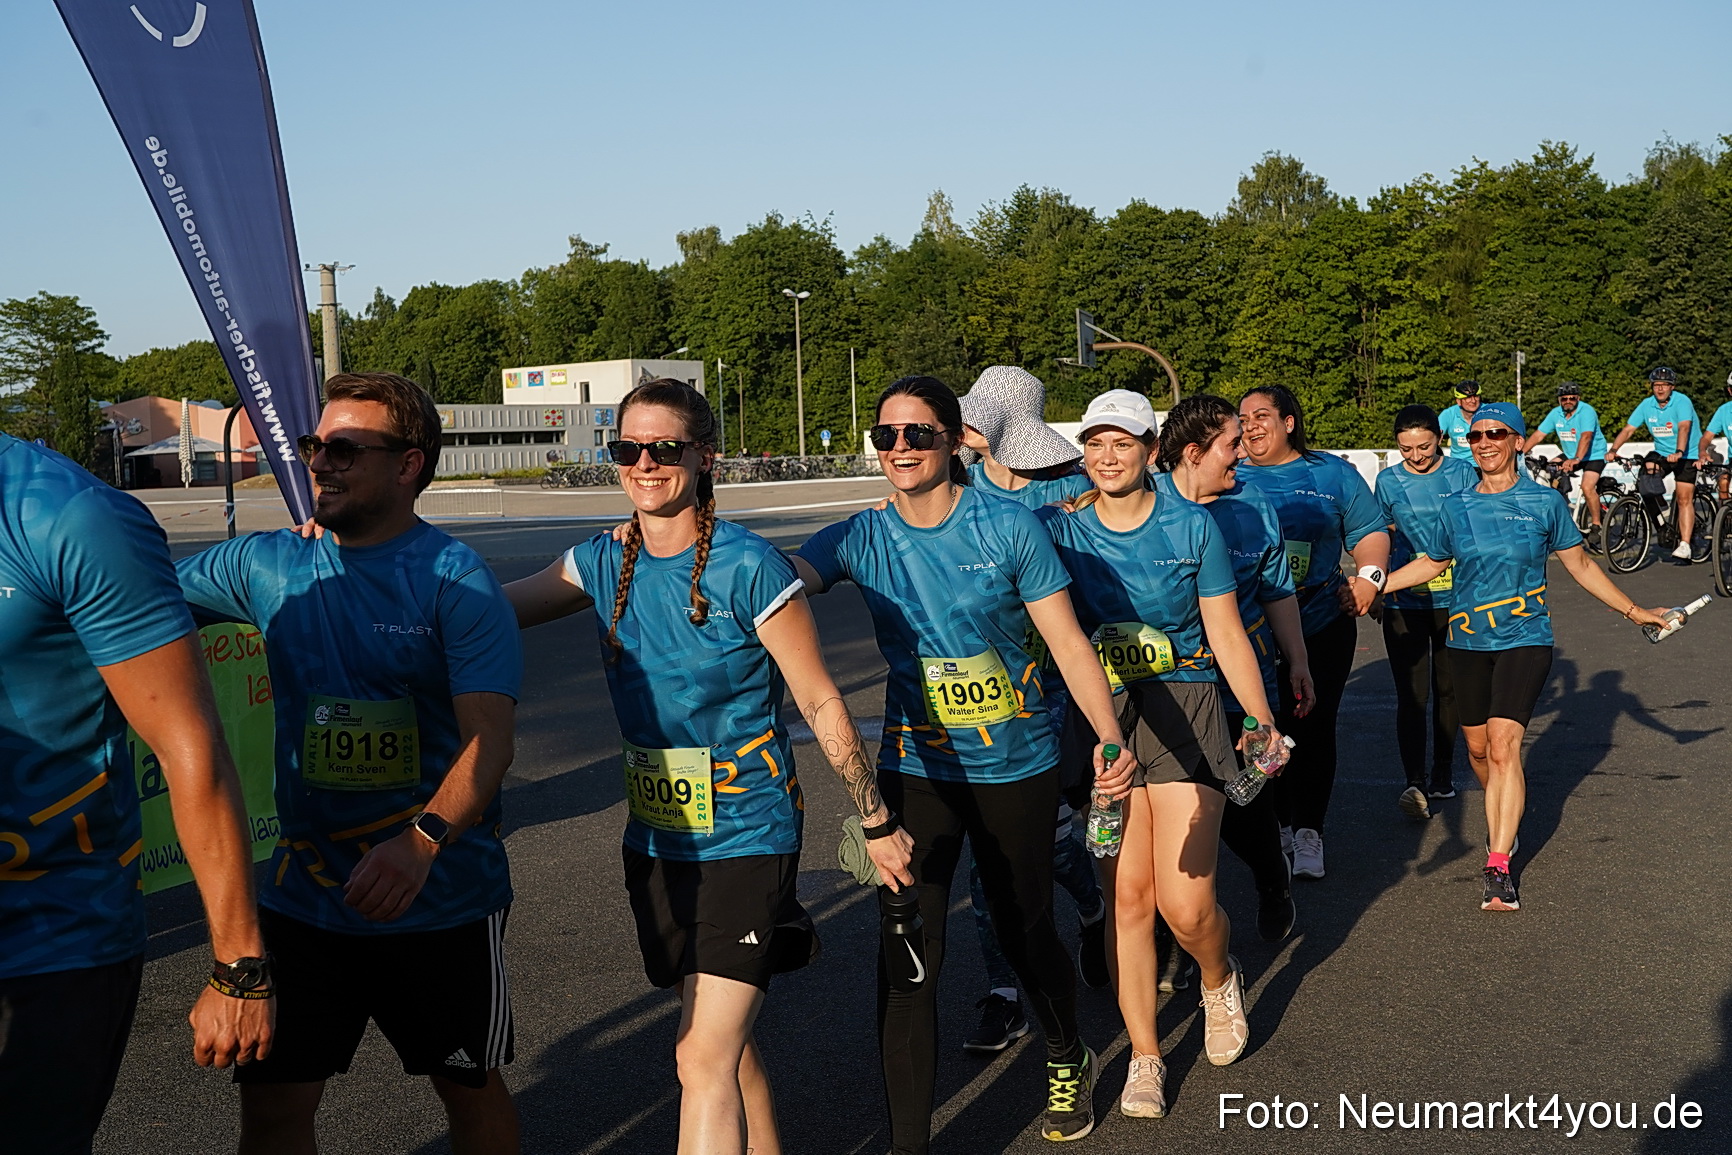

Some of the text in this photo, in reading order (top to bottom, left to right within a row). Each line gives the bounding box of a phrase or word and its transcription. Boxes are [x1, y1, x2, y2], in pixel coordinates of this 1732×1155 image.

[1233, 549, 1264, 558] PLAST
[707, 609, 734, 619] LAST
[388, 624, 433, 637] PLAST
[1098, 643, 1157, 668] 1900
[1158, 644, 1171, 672] 2022
[1131, 666, 1148, 675] Lea
[927, 685, 940, 719] WALK
[937, 676, 1002, 706] 1903
[1000, 673, 1015, 708] 2022
[947, 704, 999, 716] Walter Sina
[308, 730, 319, 774] WALK
[320, 728, 399, 762] 1918
[402, 733, 414, 774] 2022
[328, 762, 387, 774] Kern Sven
[632, 771, 692, 806] 1909
[695, 782, 707, 821] 2022
[641, 800, 684, 819] Kraut Anja
[444, 1058, 478, 1069] adidas
